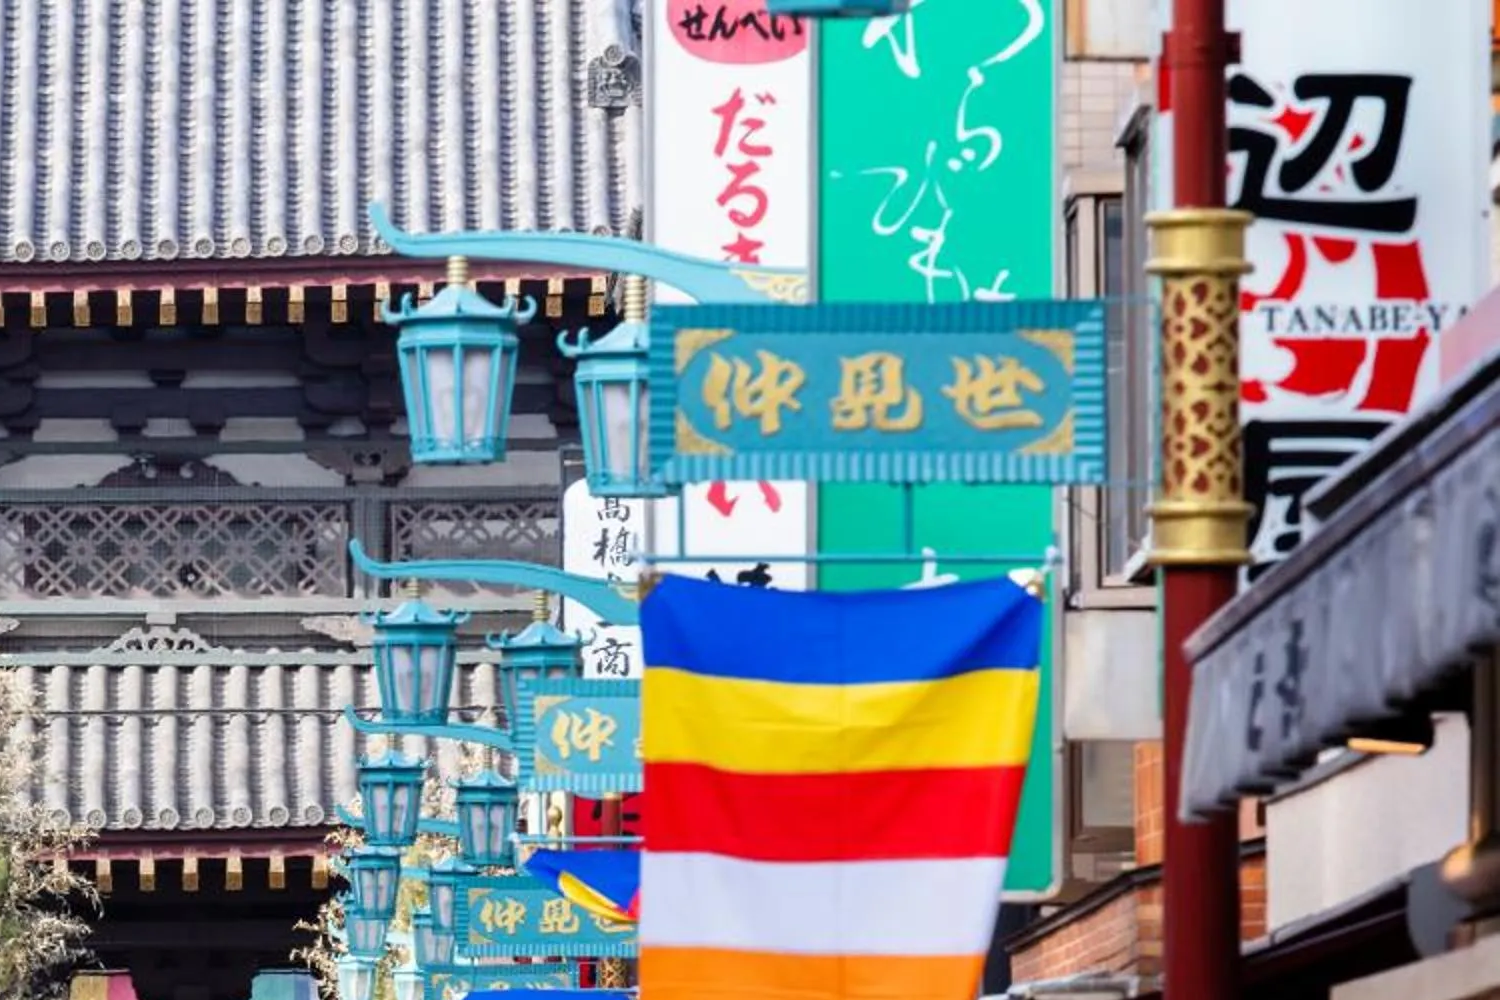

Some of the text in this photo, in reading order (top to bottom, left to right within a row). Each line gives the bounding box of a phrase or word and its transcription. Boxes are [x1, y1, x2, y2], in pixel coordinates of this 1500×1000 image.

[679, 5, 804, 42] せんべい
[702, 349, 1045, 436] 仲見世
[552, 707, 643, 762] 仲
